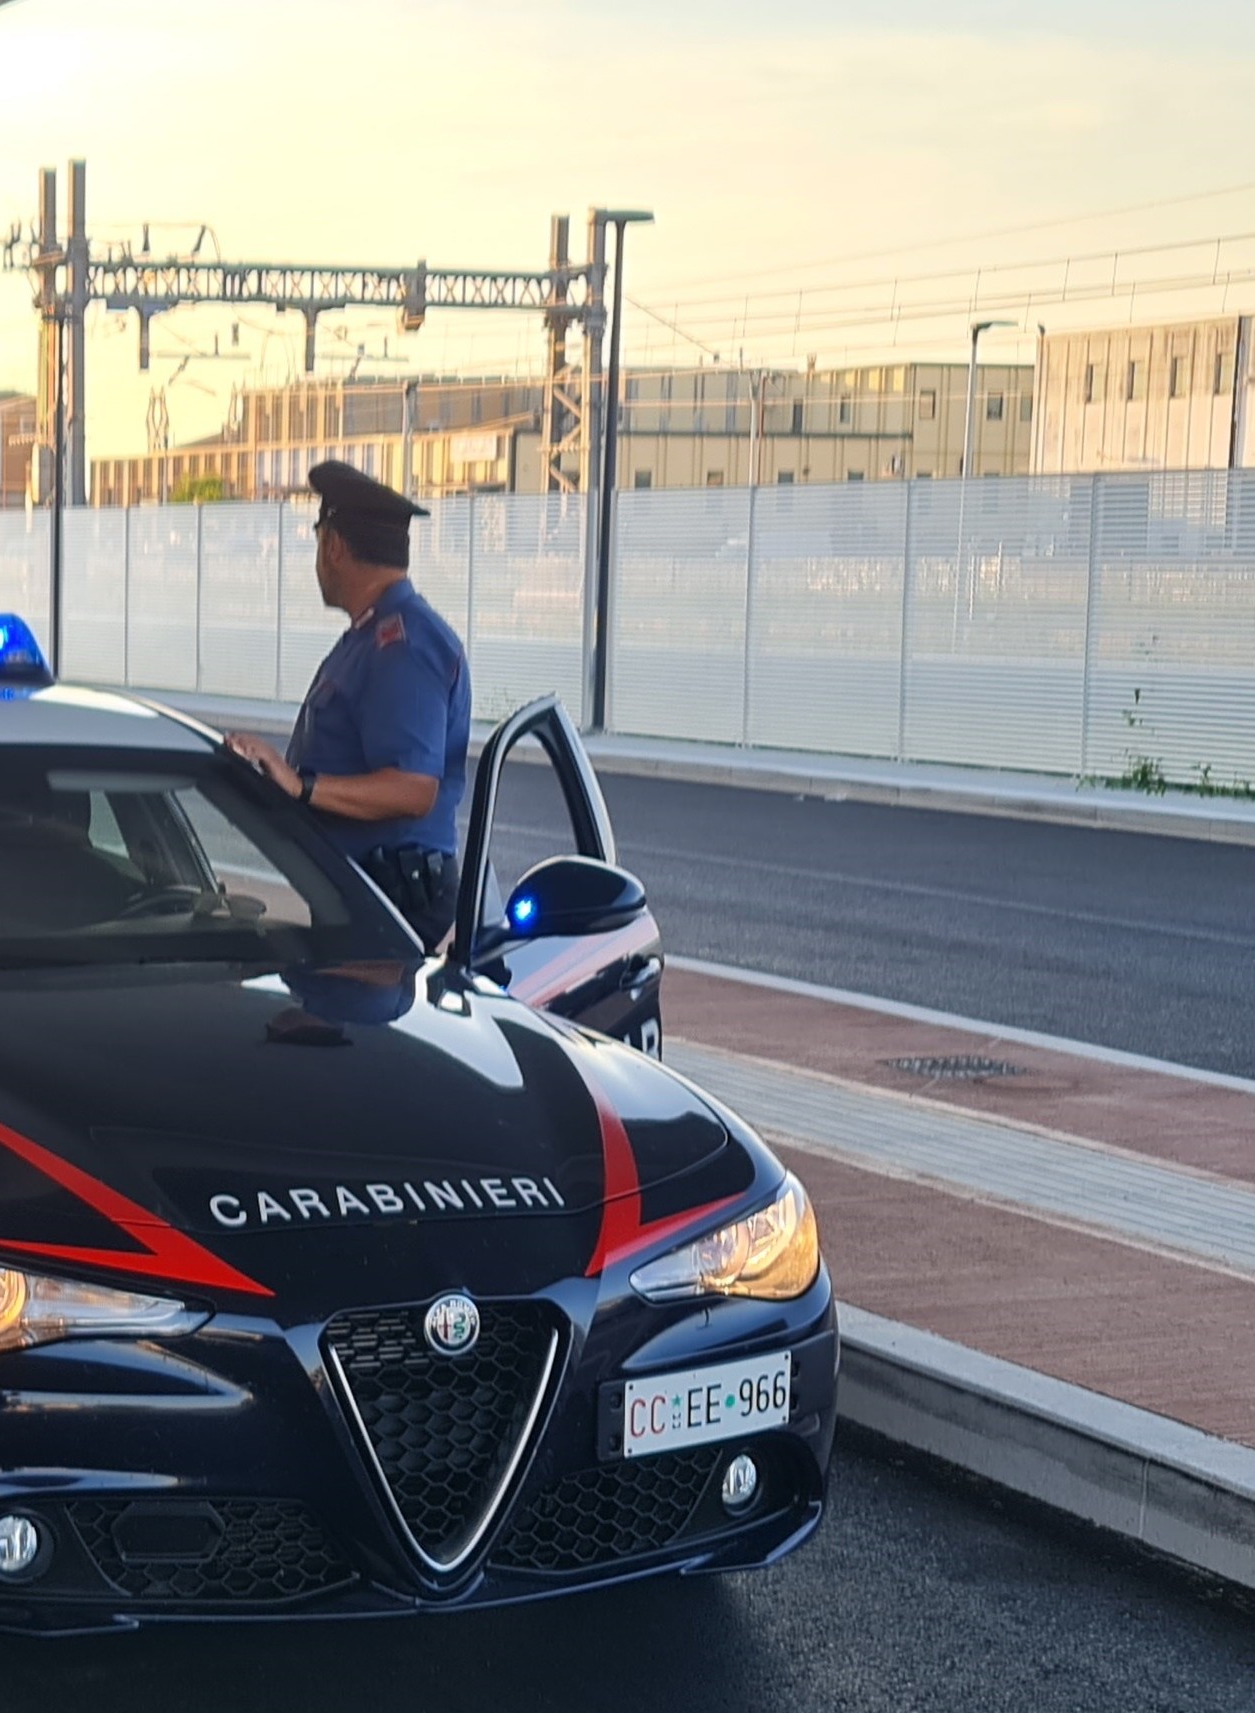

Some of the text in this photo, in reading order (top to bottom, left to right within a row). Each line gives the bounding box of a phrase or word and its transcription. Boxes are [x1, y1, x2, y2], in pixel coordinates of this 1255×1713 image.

[209, 1176, 565, 1228] CARABINIERI
[630, 1370, 787, 1438] CC EE 966
